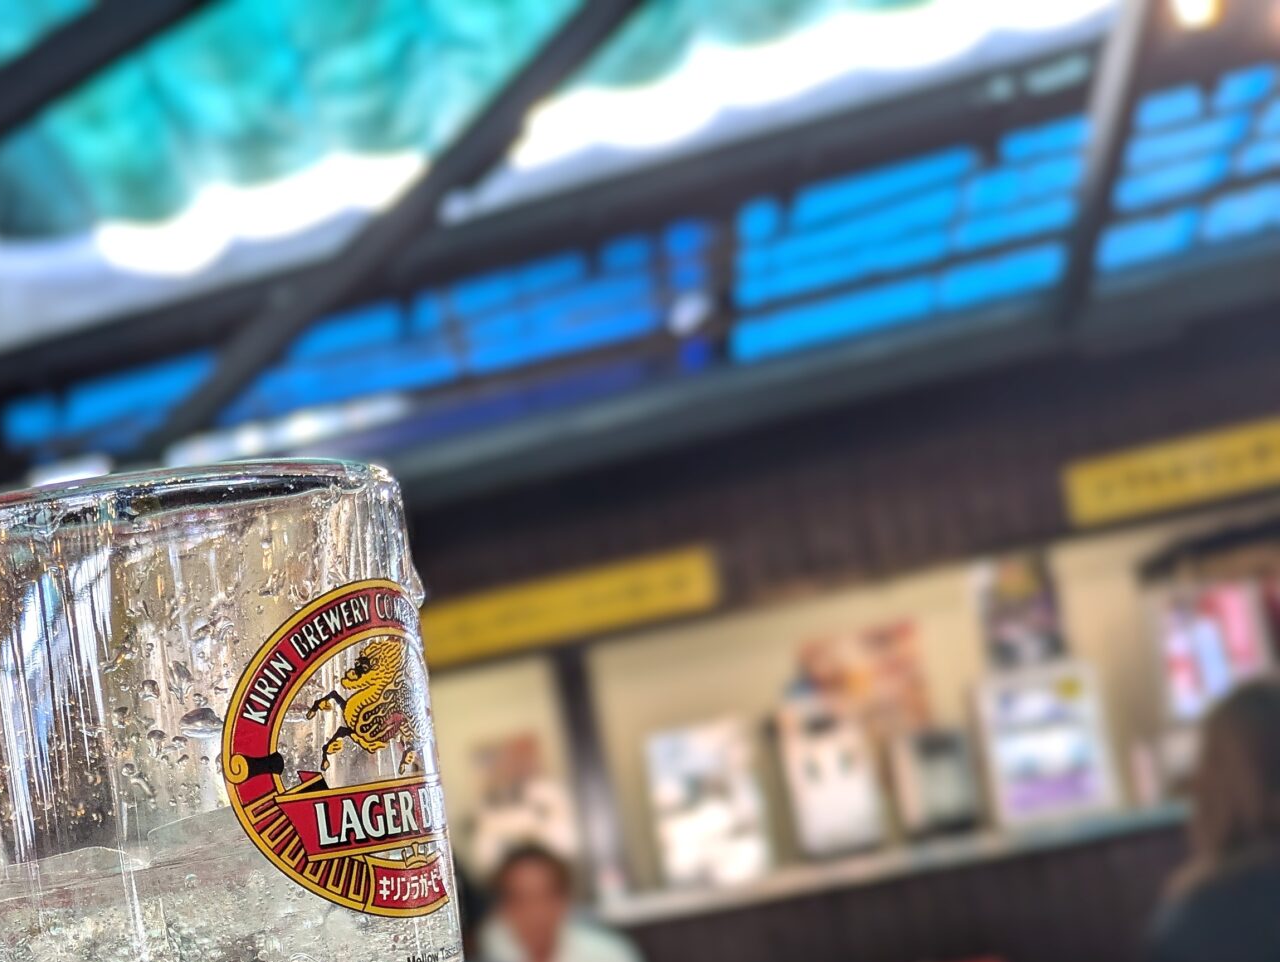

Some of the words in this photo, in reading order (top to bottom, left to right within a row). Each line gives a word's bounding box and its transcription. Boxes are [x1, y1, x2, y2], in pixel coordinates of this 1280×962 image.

[243, 652, 294, 725] KIRIN
[290, 596, 370, 658] BREWERY
[314, 791, 418, 846] LAGER
